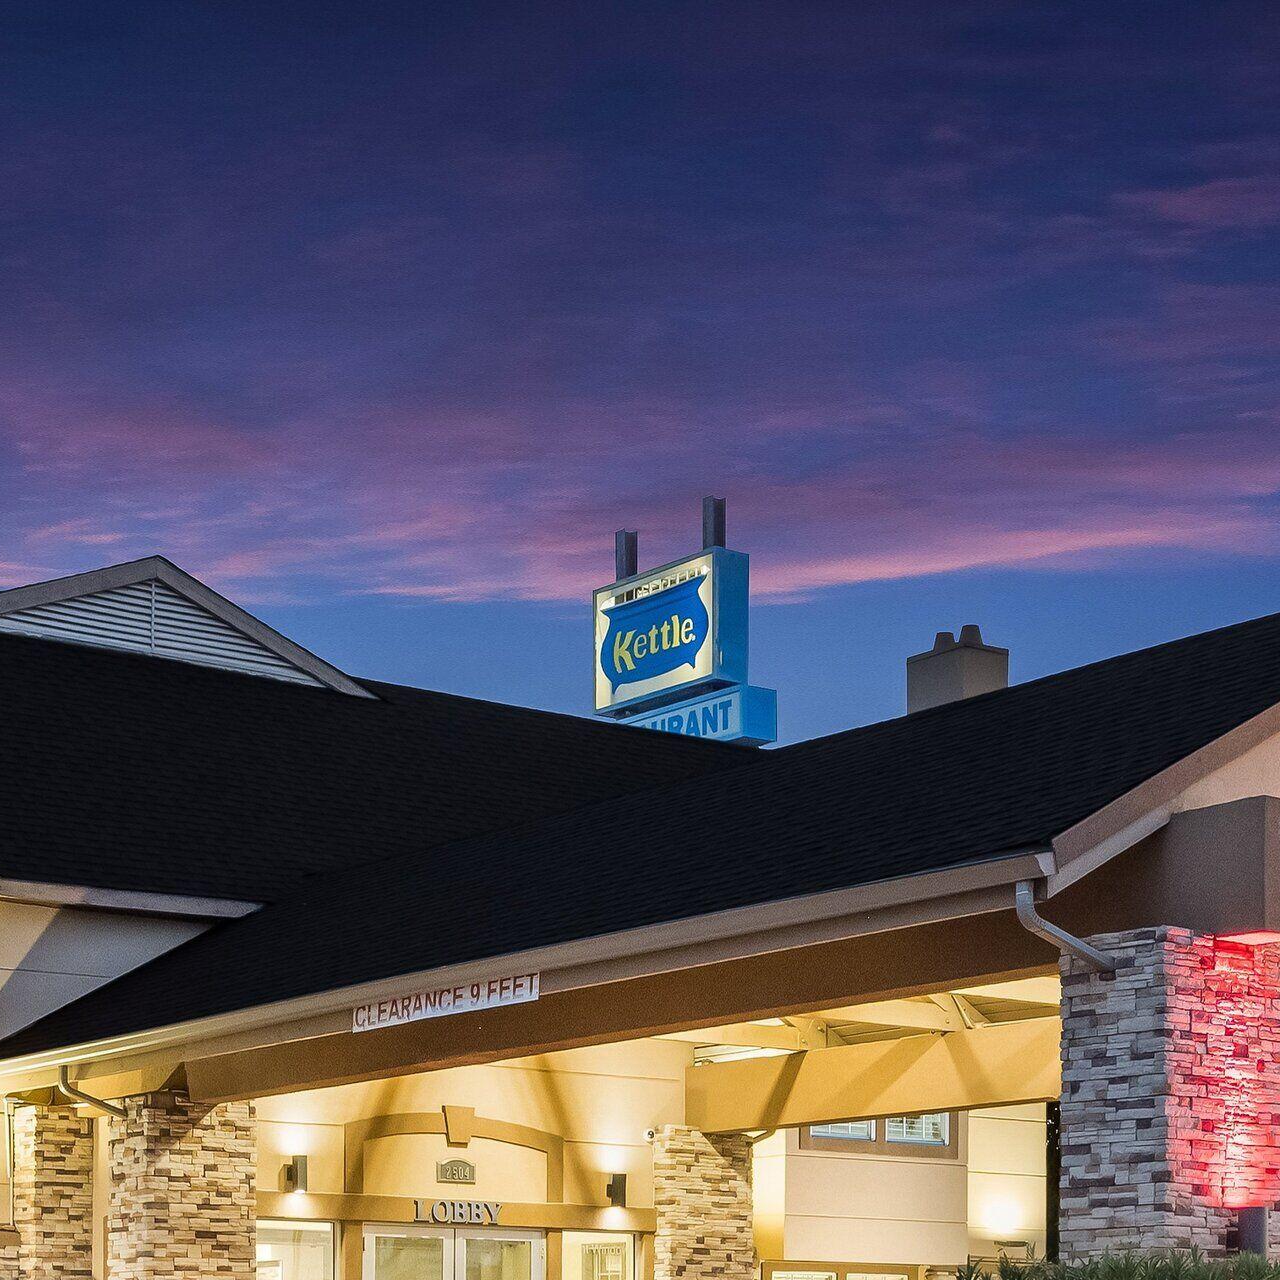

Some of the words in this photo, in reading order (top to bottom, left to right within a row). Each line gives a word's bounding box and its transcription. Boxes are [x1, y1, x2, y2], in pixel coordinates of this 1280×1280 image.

[613, 614, 696, 673] Kettle
[354, 986, 464, 1028] CLEARANCE
[470, 983, 481, 1004] 9
[487, 973, 539, 1001] FEET
[414, 1199, 502, 1224] LOBBY
